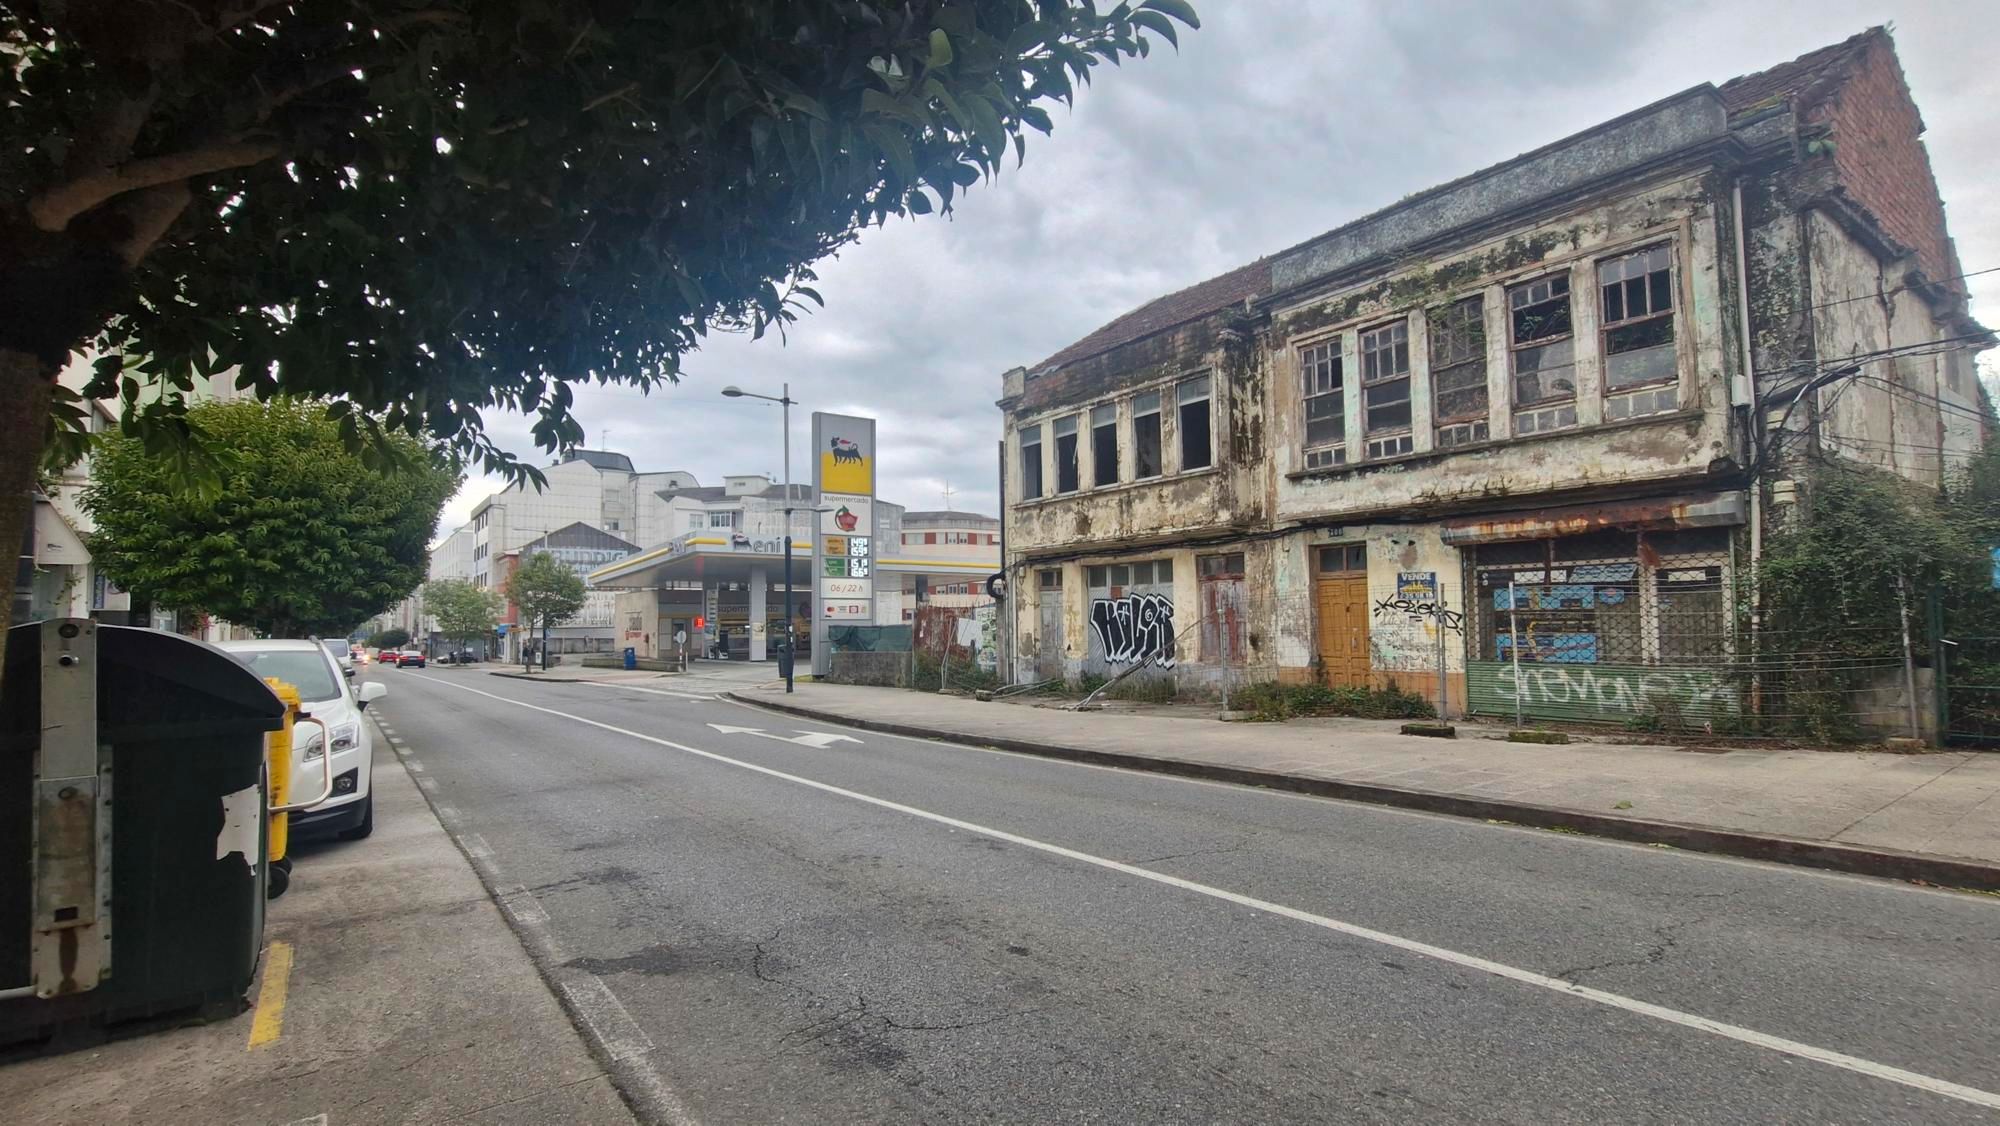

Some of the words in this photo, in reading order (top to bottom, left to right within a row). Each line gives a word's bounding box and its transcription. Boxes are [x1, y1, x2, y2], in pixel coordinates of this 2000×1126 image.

[824, 495, 869, 504] supermercado
[753, 537, 781, 553] eni
[1401, 572, 1432, 581] VENDE
